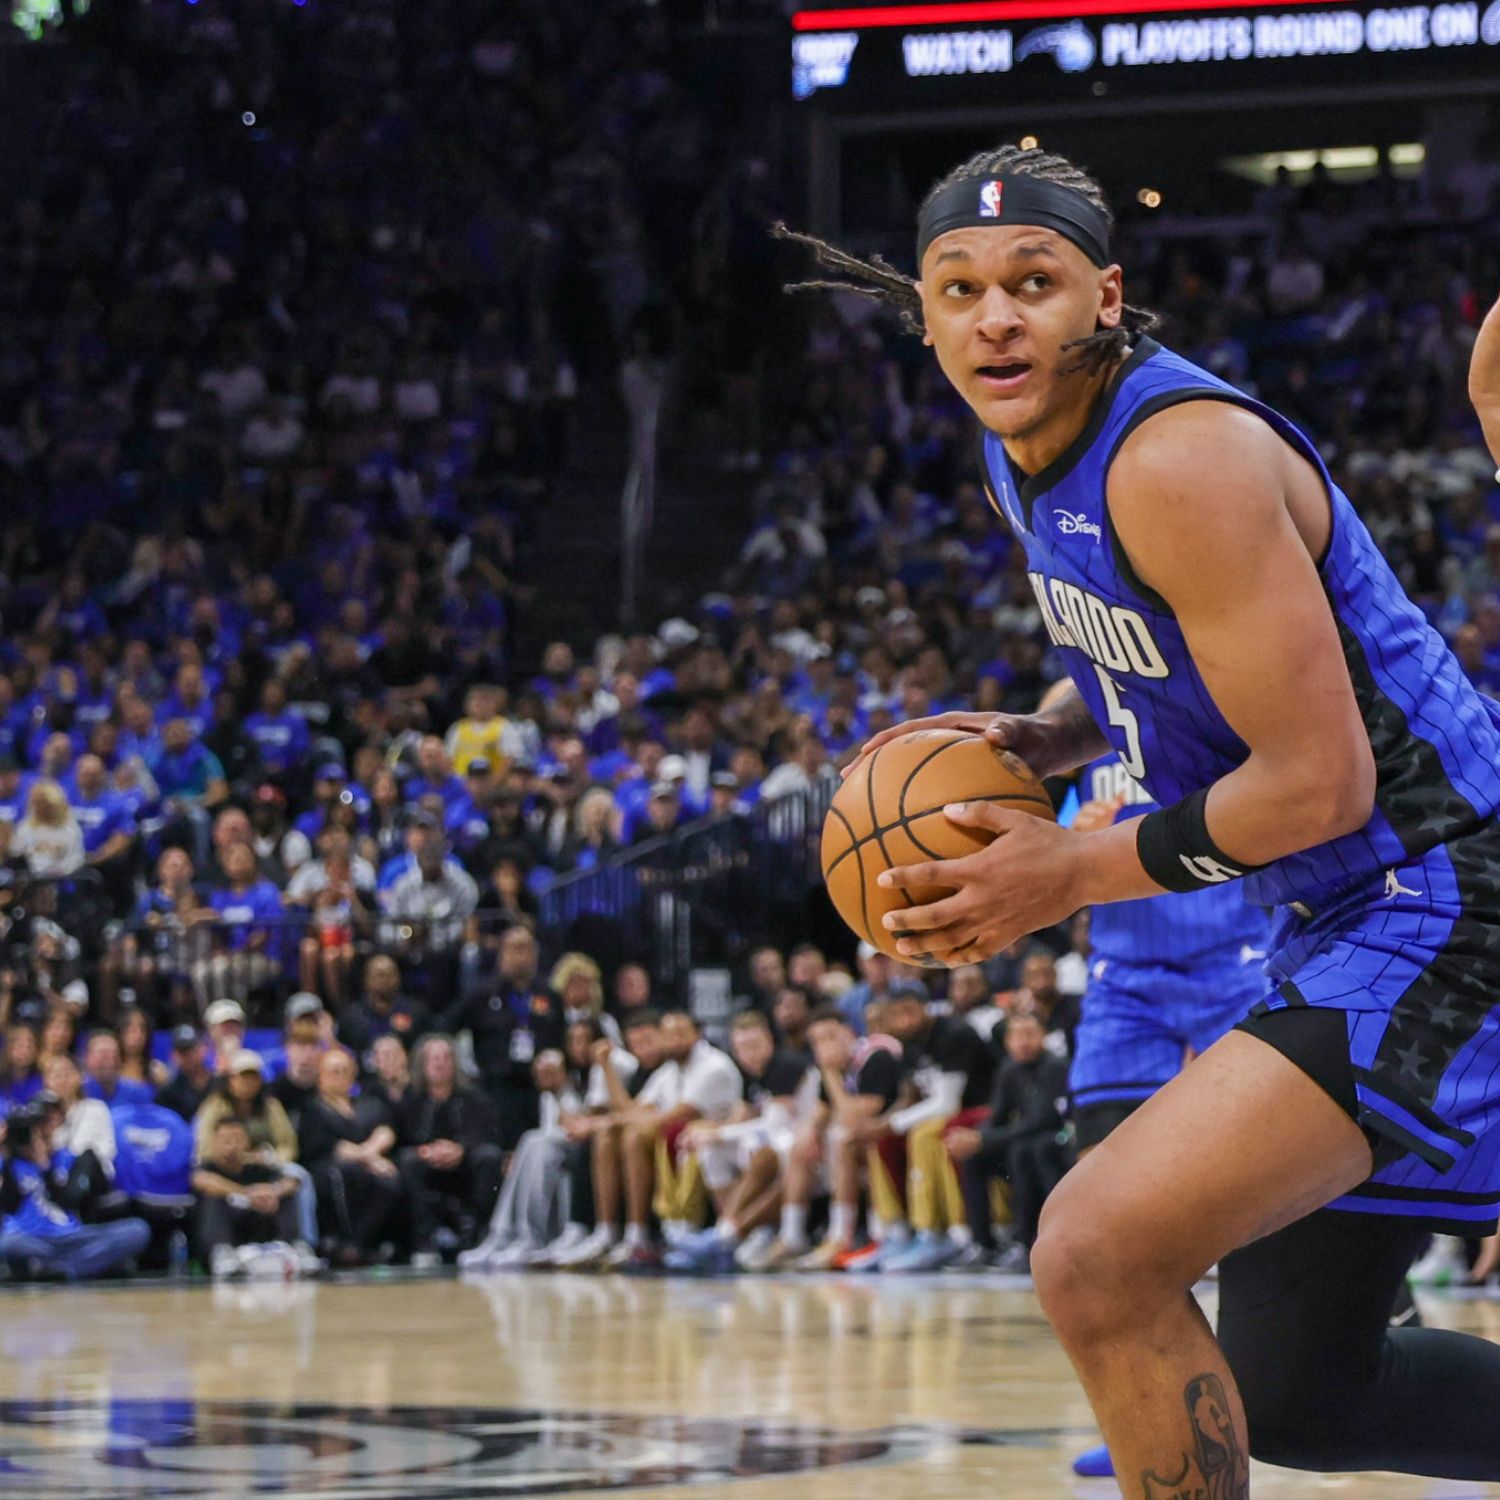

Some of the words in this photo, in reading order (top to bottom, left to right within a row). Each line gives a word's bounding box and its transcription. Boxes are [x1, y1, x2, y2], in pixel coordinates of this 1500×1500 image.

[903, 30, 1012, 76] WATCH
[1102, 16, 1250, 66] PLAYOFFS
[1253, 11, 1364, 57] ROUND
[1365, 6, 1430, 51] ONE
[1431, 2, 1478, 47] ON
[1053, 509, 1101, 545] Disney
[1093, 664, 1146, 779] 5
